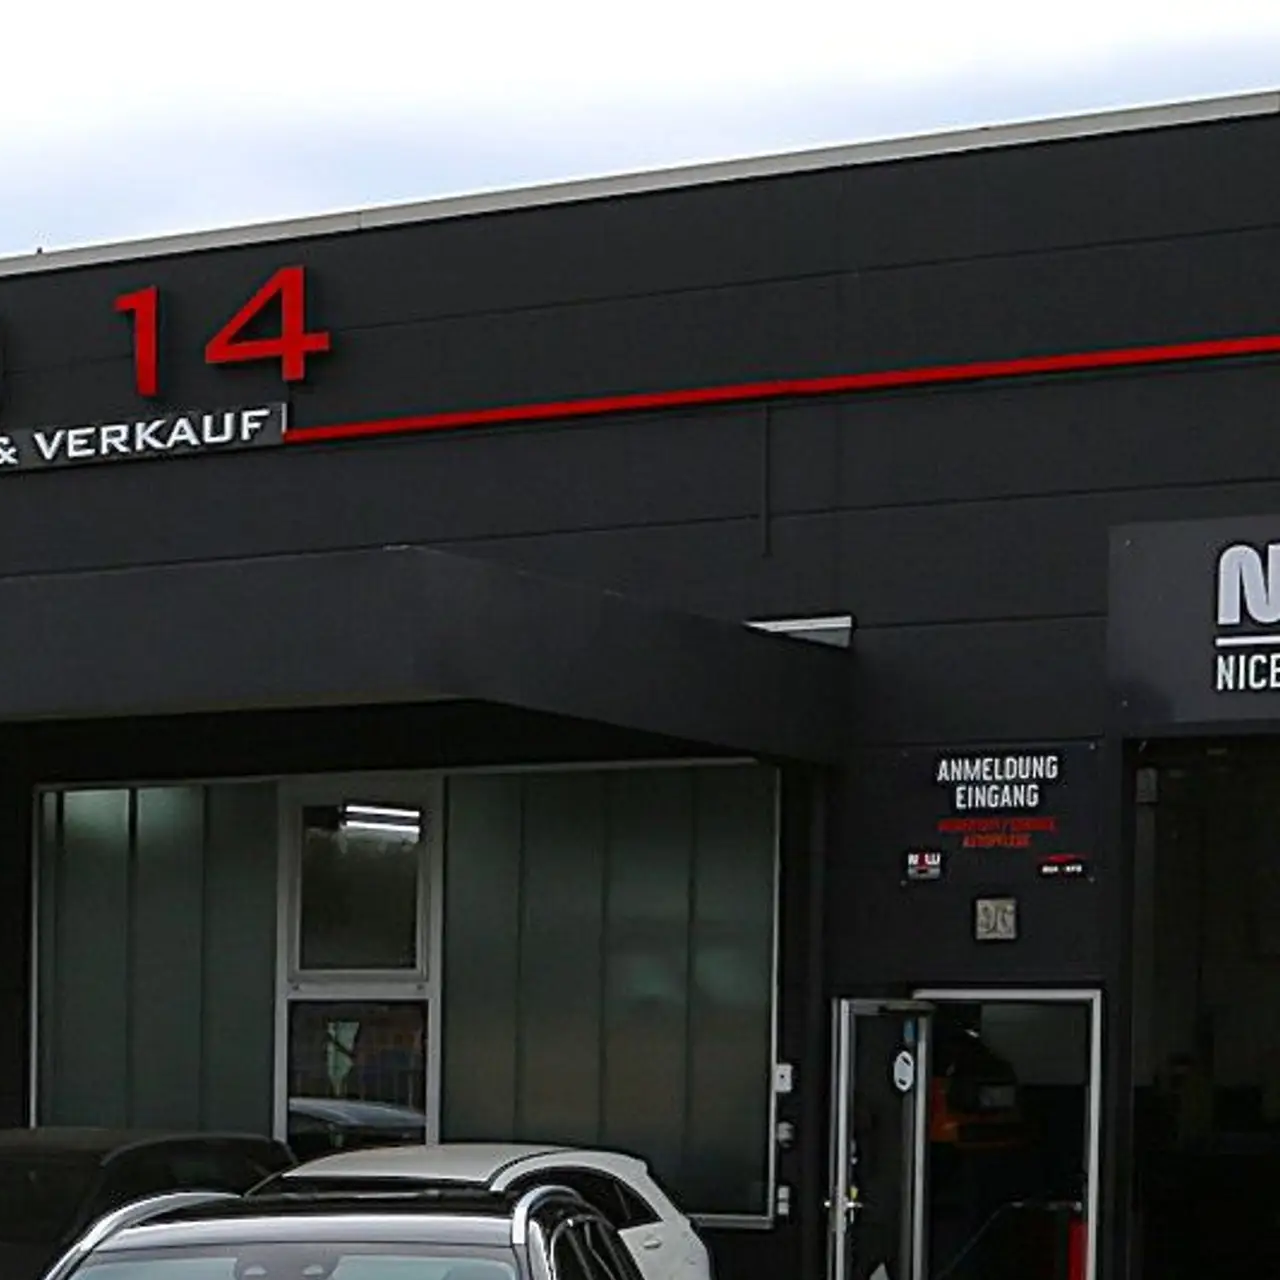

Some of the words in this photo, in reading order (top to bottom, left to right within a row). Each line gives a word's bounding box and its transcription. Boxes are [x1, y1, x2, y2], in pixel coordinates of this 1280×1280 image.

[113, 265, 331, 396] 14
[33, 407, 271, 461] VERKAUF
[936, 755, 1059, 781] ANMELDUNG
[955, 784, 1040, 809] EINGANG
